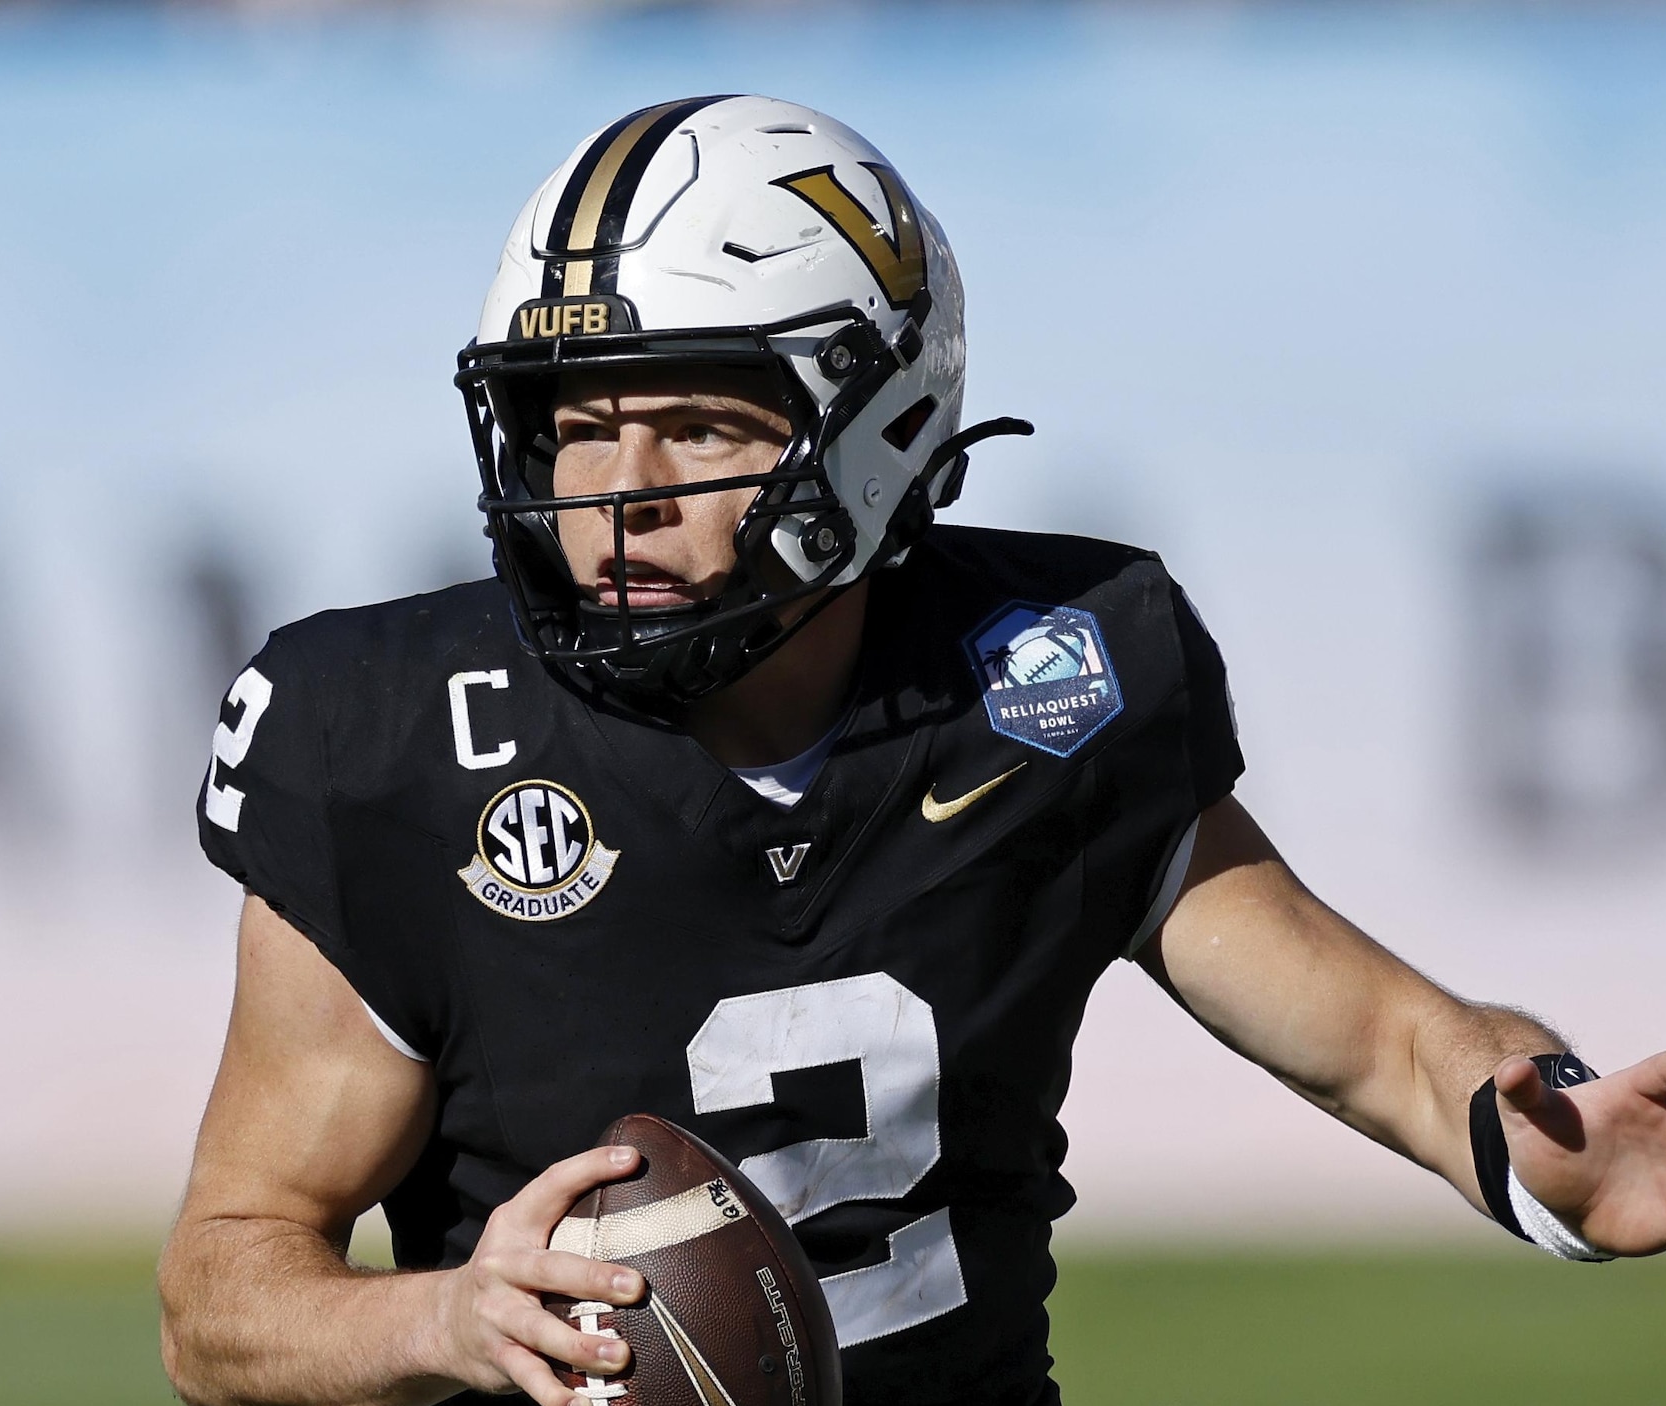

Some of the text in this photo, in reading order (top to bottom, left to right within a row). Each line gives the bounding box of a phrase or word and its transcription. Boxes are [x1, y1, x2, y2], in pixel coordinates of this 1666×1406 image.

[768, 161, 929, 311] V
[519, 303, 609, 340] VUFB
[448, 669, 517, 770] C
[1000, 693, 1099, 720] RELIAQUEST
[1039, 715, 1076, 730] BOWL
[206, 667, 274, 832] 2
[487, 788, 583, 884] SEC
[765, 842, 812, 882] V
[482, 871, 600, 917] GRADUATE
[686, 971, 968, 1350] 2
[756, 1266, 797, 1347] ELITE
